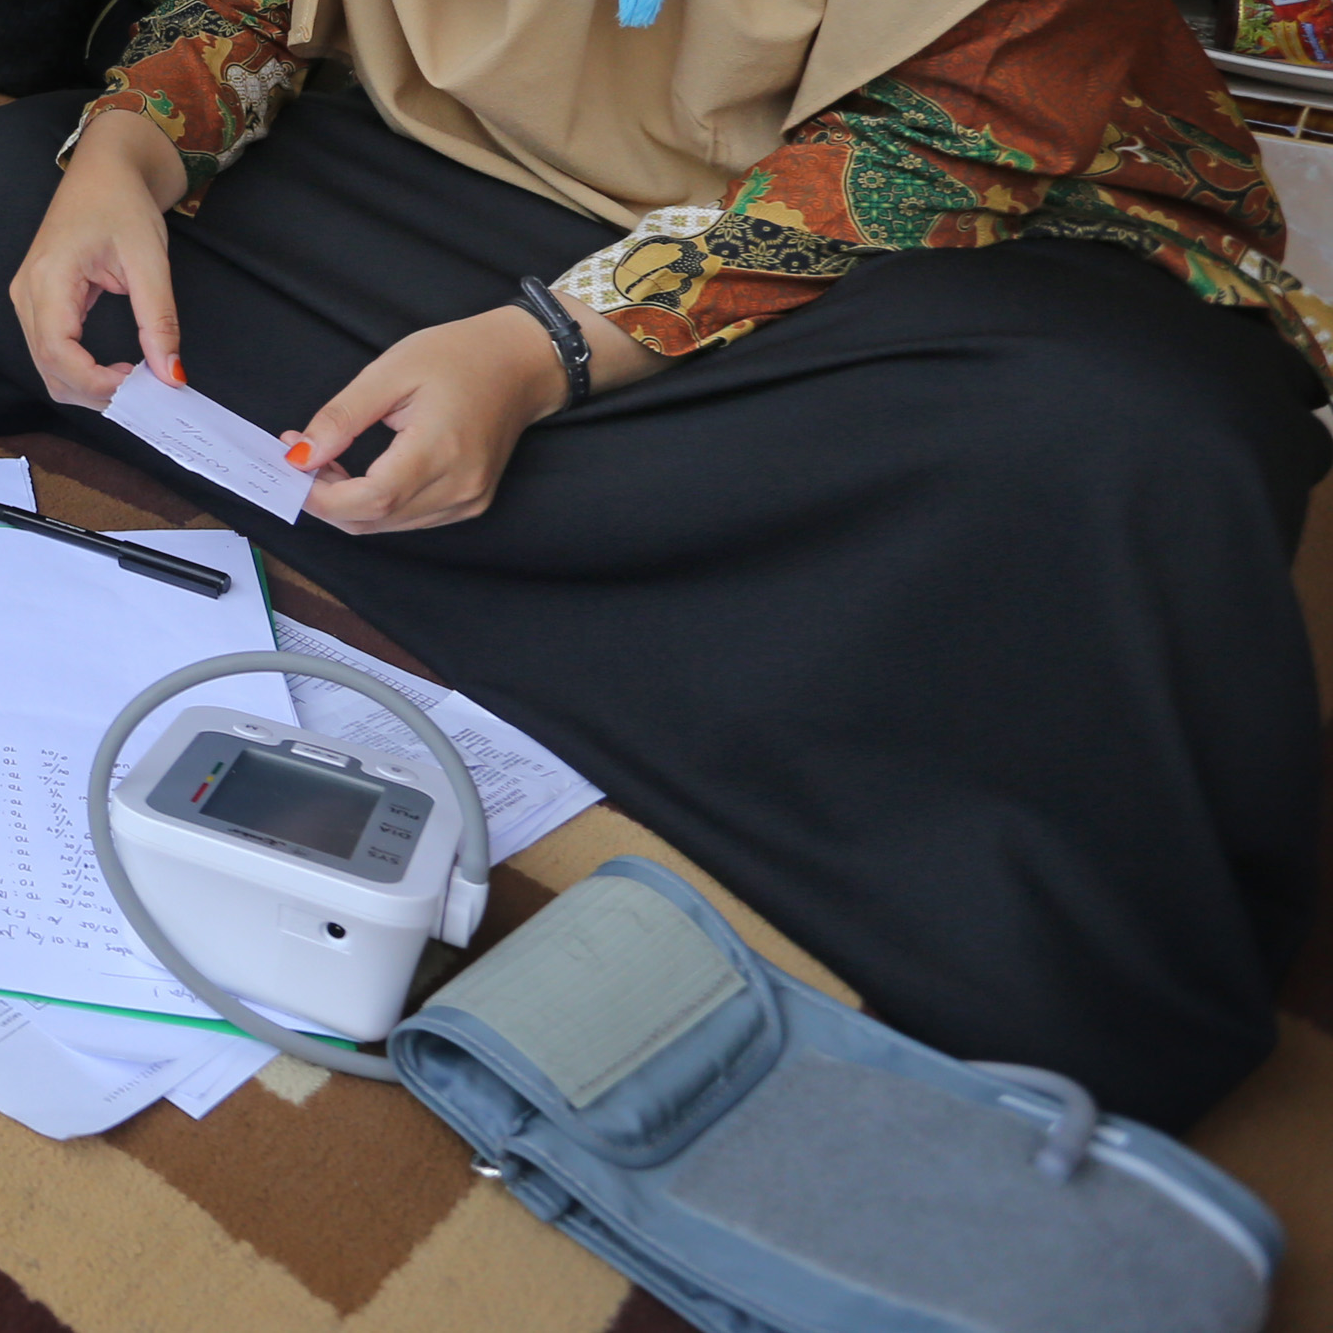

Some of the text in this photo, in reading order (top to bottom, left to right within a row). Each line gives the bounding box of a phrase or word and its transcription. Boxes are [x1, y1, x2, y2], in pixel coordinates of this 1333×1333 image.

[389, 807, 420, 821] PUL
[379, 826, 412, 840] DIA
[367, 850, 400, 865] SYS
